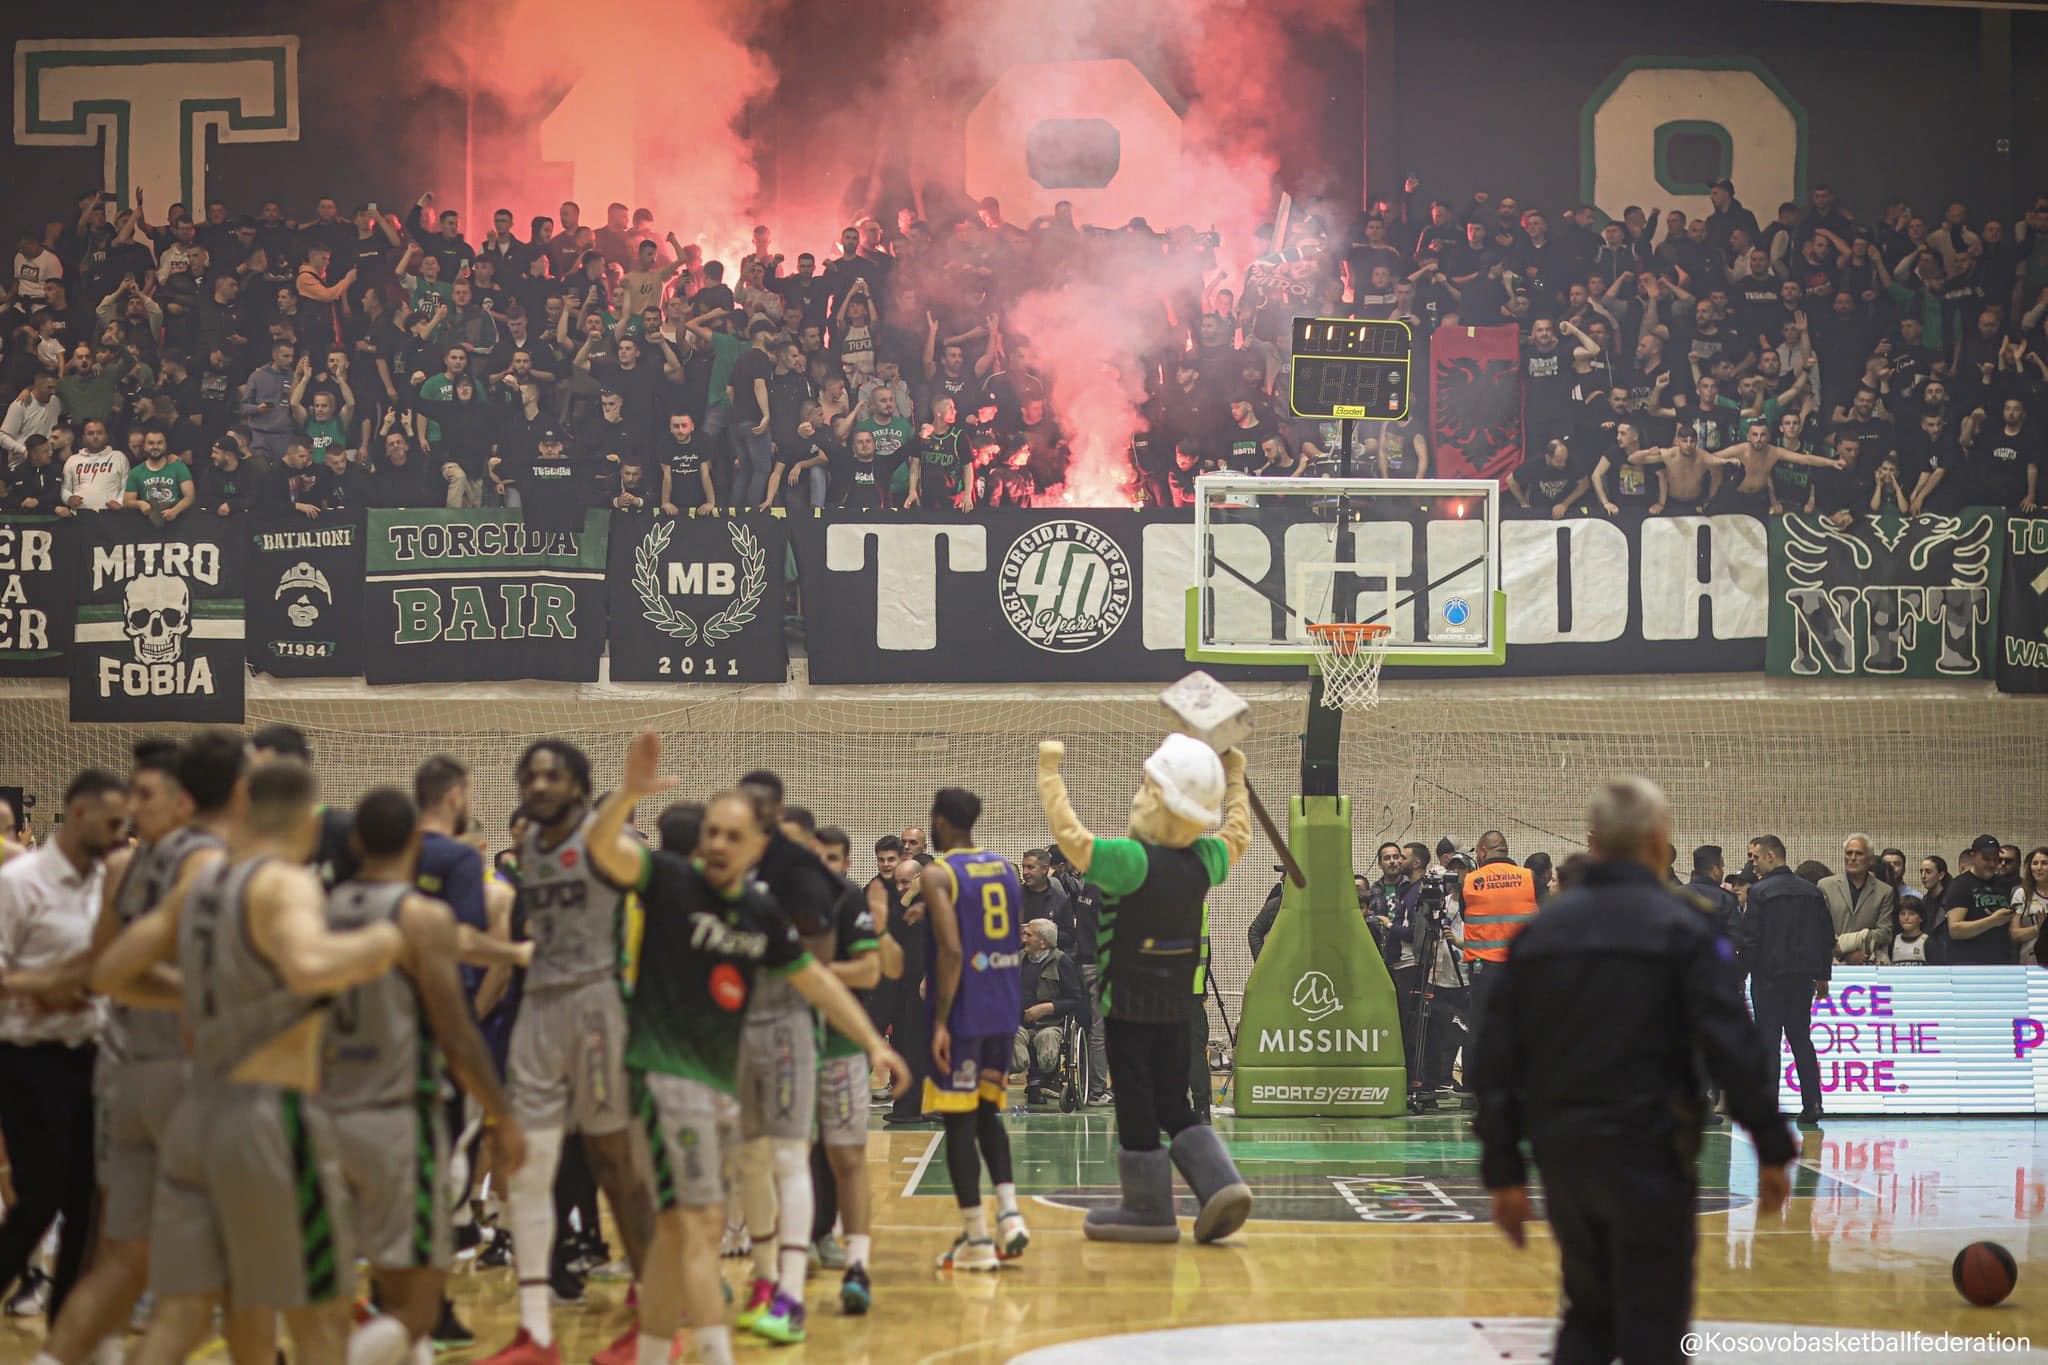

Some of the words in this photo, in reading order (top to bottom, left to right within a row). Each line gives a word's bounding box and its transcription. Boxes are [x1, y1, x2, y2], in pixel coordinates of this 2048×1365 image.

[1335, 406, 1363, 416] Bodet
[76, 459, 112, 487] GUCCI
[263, 529, 351, 550] BATALIONI
[389, 523, 578, 560] TORCIDA
[1002, 524, 1069, 591] TORCIDA
[1074, 525, 1129, 591] TREPCA
[93, 542, 219, 591] MITRO
[668, 562, 736, 596] MB
[1016, 541, 1110, 639] 40
[393, 583, 577, 645] BAIR
[1003, 591, 1033, 633] 1984
[1036, 610, 1097, 646] Years
[1097, 593, 1127, 636] 2024
[1786, 586, 1989, 675] NFT
[277, 641, 327, 657] T1984
[658, 656, 739, 676] 2011
[100, 656, 214, 697] FOBIA
[1486, 873, 1522, 883] ILLYRIAN
[1486, 881, 1522, 890] SECURITY
[981, 882, 1010, 940] 8
[1811, 985, 1893, 1017] ACE
[1867, 1023, 1941, 1054] THE
